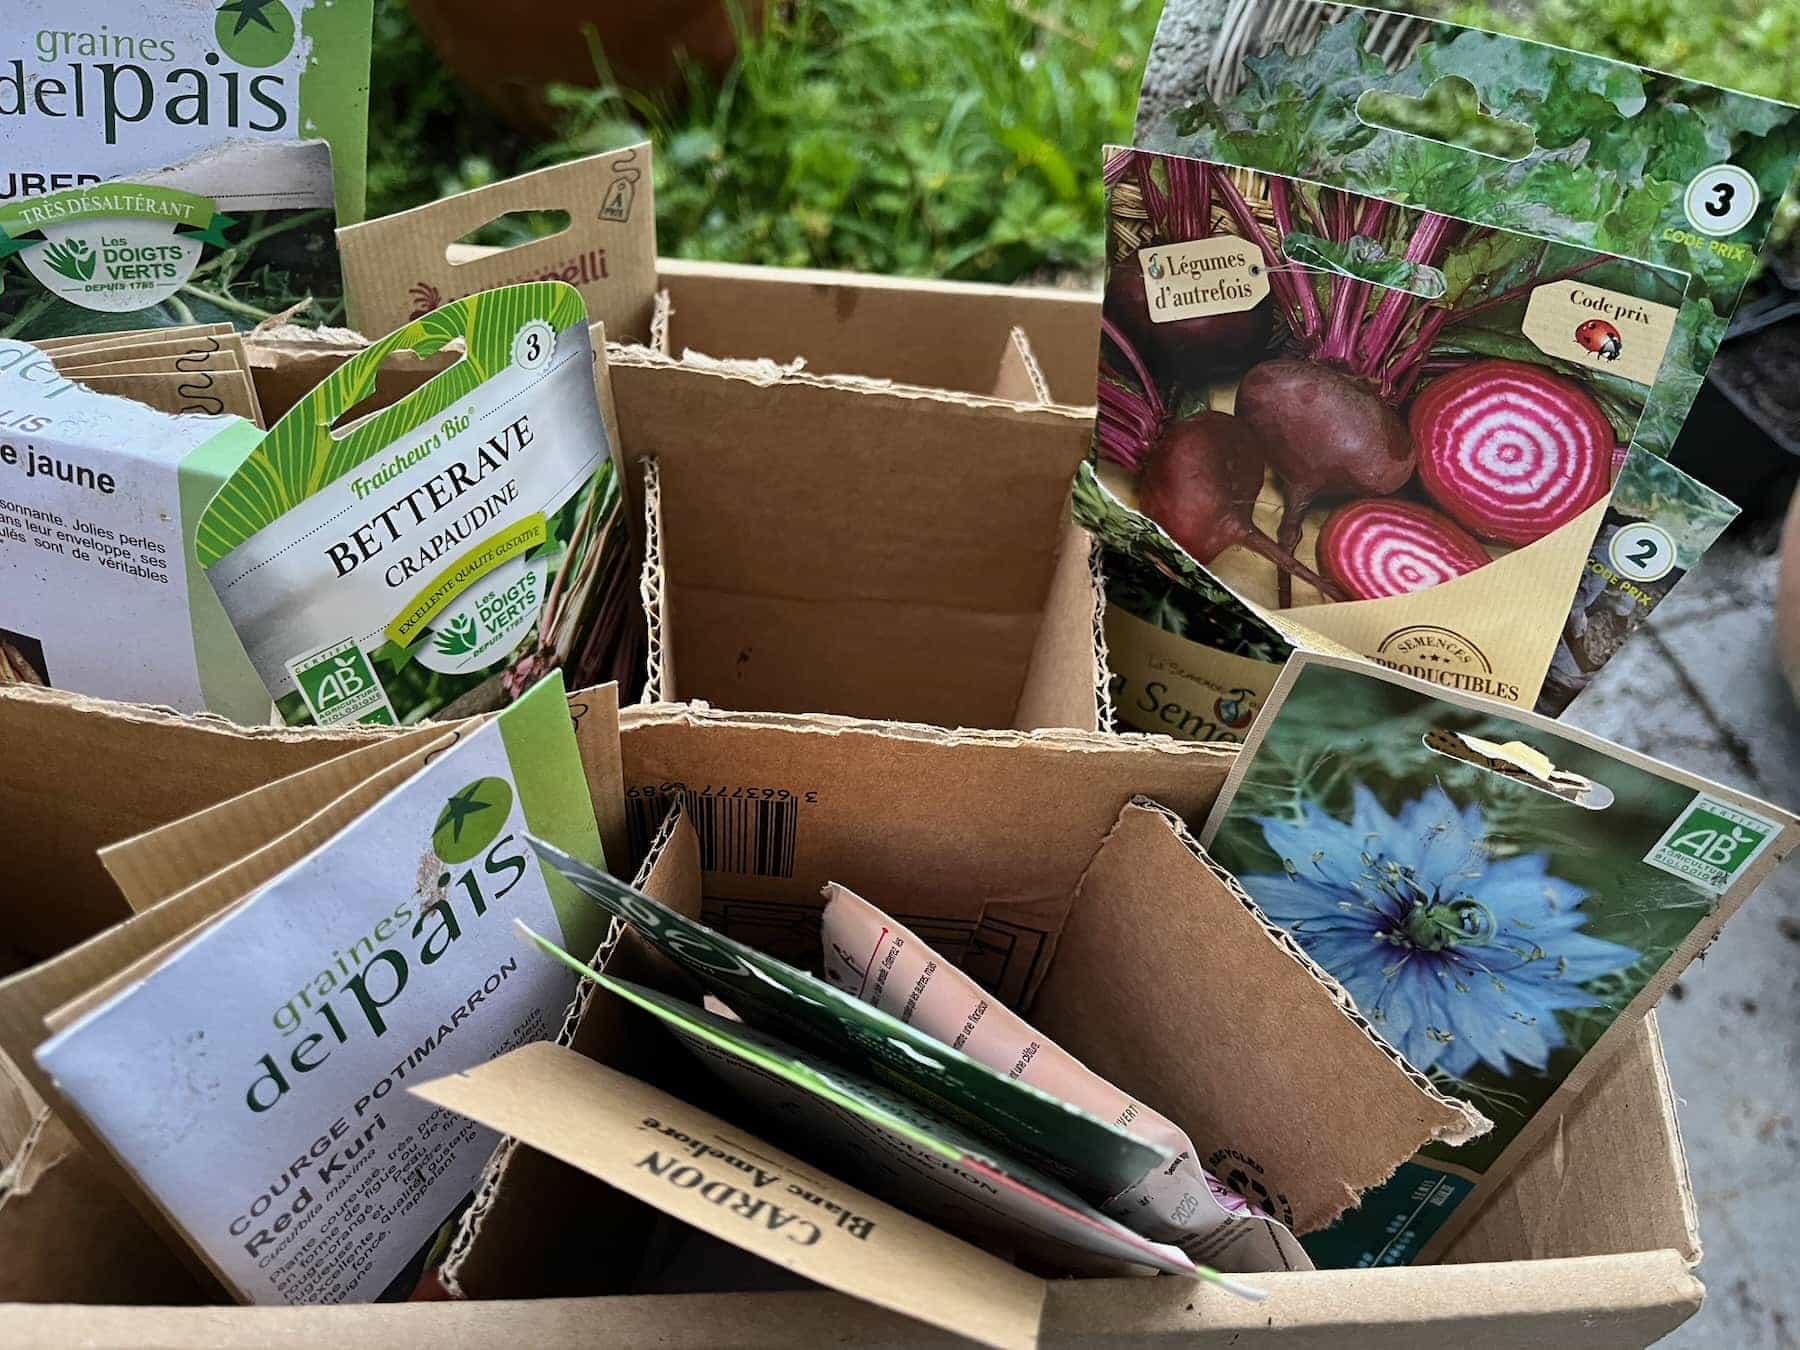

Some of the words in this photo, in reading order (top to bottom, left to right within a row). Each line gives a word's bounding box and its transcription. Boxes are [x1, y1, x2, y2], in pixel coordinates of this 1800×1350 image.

[36, 25, 175, 62] graines
[19, 200, 65, 225] TRÈS
[67, 193, 194, 220] DÉSALTÉRANT
[1704, 183, 1735, 217] 3
[102, 236, 128, 247] Les
[104, 246, 183, 263] DOIGTS
[1662, 228, 1704, 249] CODE
[1708, 240, 1749, 262] PRIX
[107, 263, 177, 280] VERTS
[1166, 252, 1245, 281] Légumes
[85, 284, 125, 292] DEPUIS
[1155, 278, 1253, 310] d'autrefois
[1569, 289, 1613, 315] Code
[1614, 305, 1651, 326] prix
[526, 334, 541, 362] 3
[26, 445, 116, 494] jaune
[325, 416, 534, 579] BETTERAVE
[26, 519, 52, 536] leur
[56, 531, 136, 562] enveloppe,
[141, 554, 167, 569] ses
[73, 519, 114, 540] Jolies
[119, 533, 166, 554] perles
[385, 479, 519, 589] CRAPAUDINE
[34, 537, 64, 554] sont
[72, 548, 90, 561] de
[98, 556, 168, 583] véritables
[1625, 539, 1658, 569] 2
[399, 580, 456, 635] EXCELLENTE
[455, 549, 495, 583] QUALITÉ
[495, 526, 540, 557] GUSTATIVE
[479, 571, 536, 622] DOIGTS
[1620, 581, 1653, 606] PRIX
[475, 591, 496, 609] Les
[485, 590, 536, 634] VERTS
[1397, 636, 1473, 664] SEMENCES
[318, 667, 364, 709] AB
[319, 686, 379, 719] AGRICULTURE
[701, 785, 790, 800] 663777
[805, 791, 818, 803] 3
[1671, 830, 1738, 865] AB
[272, 902, 414, 1038] graines
[227, 1115, 351, 1240] COURGE
[353, 957, 518, 1117] POTIMARRON
[242, 1184, 315, 1262] Red
[317, 1112, 387, 1186] Kuri
[636, 1150, 822, 1246] CARDON
[256, 1201, 324, 1271] Cucurbita
[323, 1146, 378, 1203] maxima
[342, 1201, 361, 1223] de
[787, 1184, 876, 1241] Blanc
[1167, 1191, 1203, 1228] 2026
